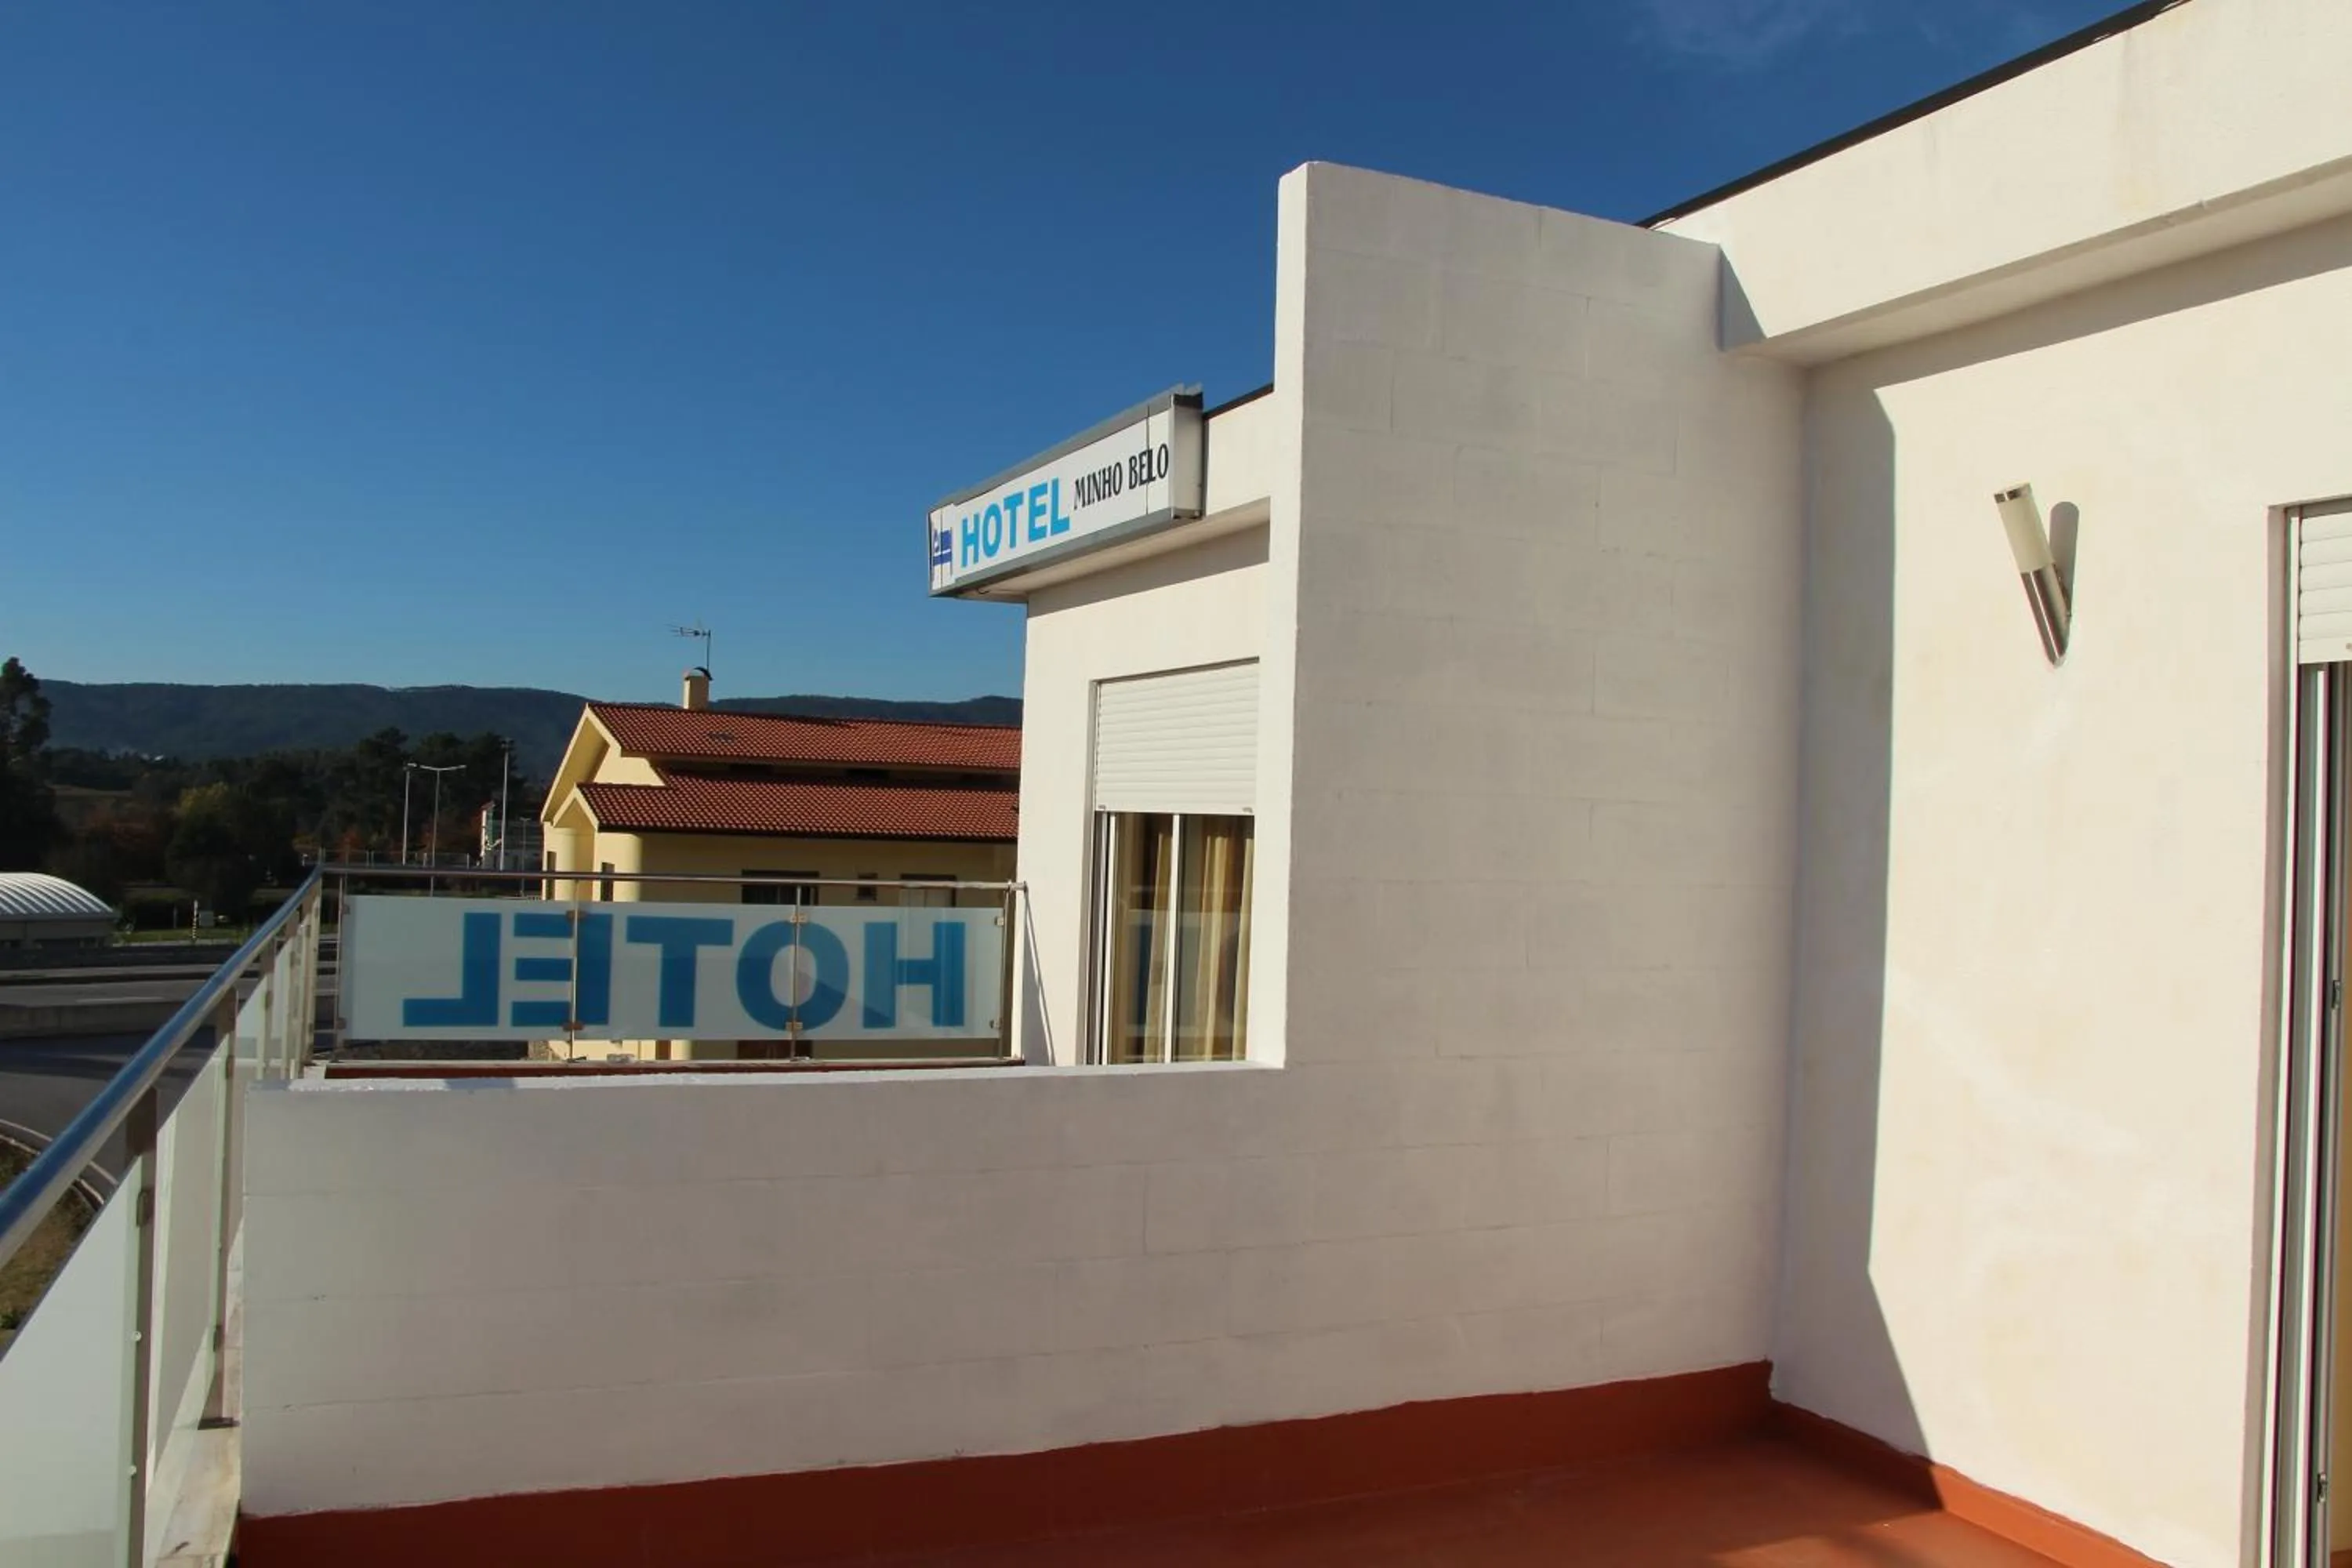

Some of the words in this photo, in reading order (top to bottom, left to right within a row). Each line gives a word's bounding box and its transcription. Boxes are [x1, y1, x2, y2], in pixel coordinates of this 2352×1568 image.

[961, 477, 1069, 567] HOTEL
[1073, 462, 1122, 510] MINHO
[1128, 443, 1169, 490] BELO
